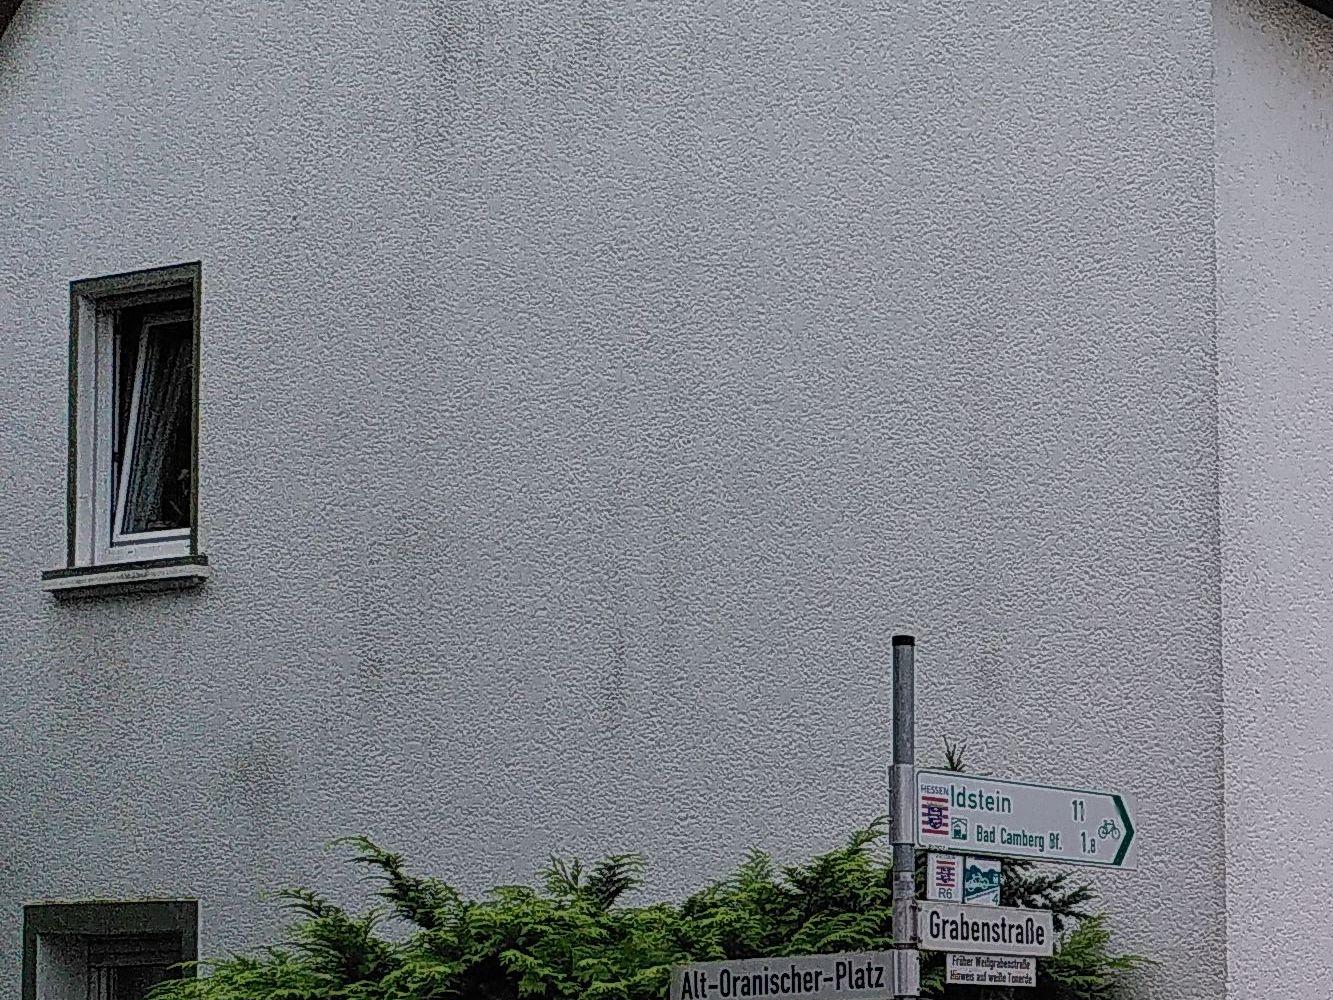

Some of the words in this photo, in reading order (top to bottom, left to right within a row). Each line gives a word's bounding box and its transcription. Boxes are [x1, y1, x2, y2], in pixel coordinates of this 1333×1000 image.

[920, 783, 949, 796] HESSEN
[950, 784, 1012, 814] Idstein
[1071, 799, 1085, 821] 11
[976, 824, 996, 844] Bad
[1000, 827, 1045, 853] Camberg
[938, 887, 953, 900] R6
[929, 910, 1045, 946] Grabenstraße
[680, 960, 885, 1000] Alt-Oranischer-Platz
